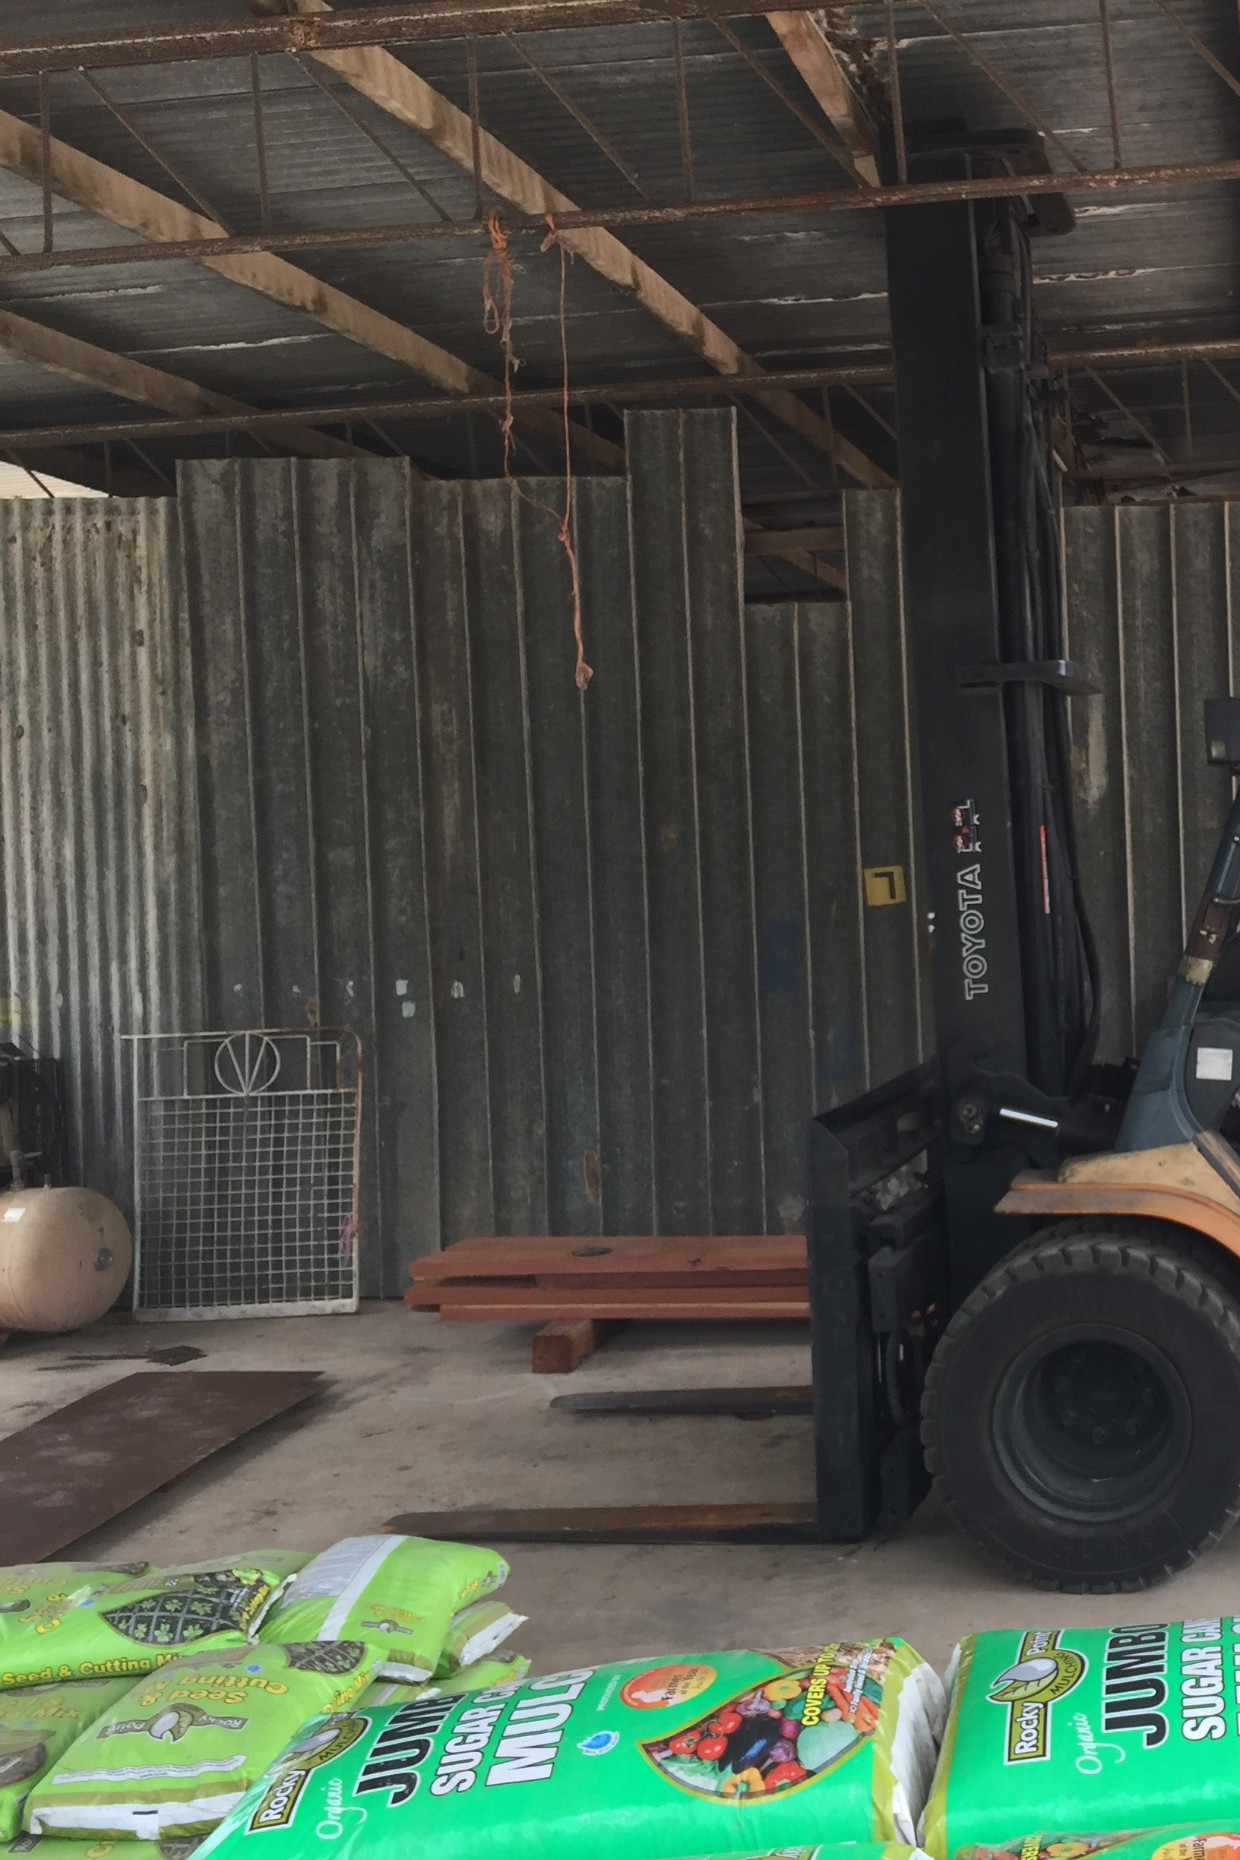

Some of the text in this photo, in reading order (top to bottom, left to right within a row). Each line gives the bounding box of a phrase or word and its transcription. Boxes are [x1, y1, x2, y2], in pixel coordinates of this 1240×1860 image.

[957, 864, 989, 1000] TOYOTA
[2, 1667, 51, 1686] Seed
[57, 1665, 73, 1679] &
[79, 1657, 151, 1675] Cutting
[812, 1663, 831, 1676] UP
[817, 1652, 835, 1663] TO
[1050, 1651, 1078, 1696] MULCHING
[169, 1690, 247, 1704] Seed
[180, 1674, 288, 1695] Cutting
[801, 1678, 828, 1726] COVERS
[1181, 1645, 1227, 1741] SUGAR
[198, 1714, 244, 1729] Rocky
[1015, 1701, 1045, 1755] Rocky
[1075, 1712, 1125, 1775] Organic
[429, 1702, 507, 1796] SUGAR
[259, 1769, 306, 1823] Rocky
[316, 1777, 368, 1840] Organic
